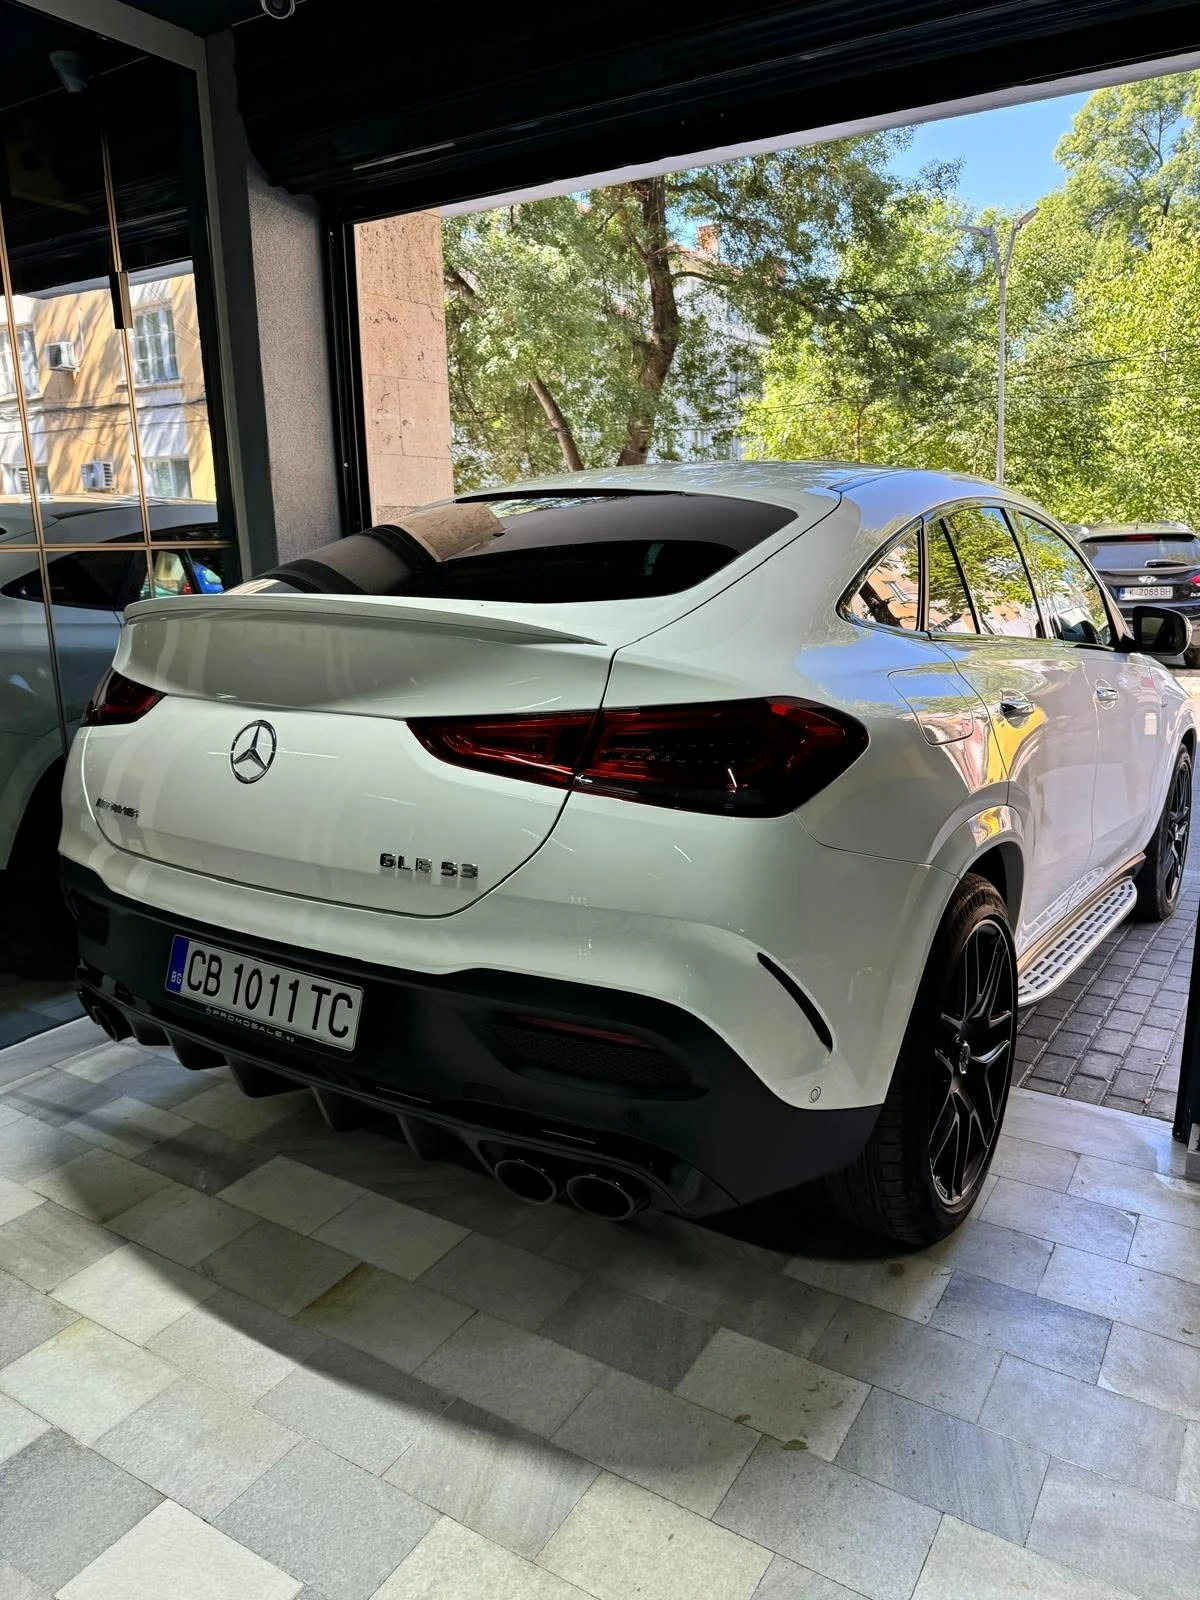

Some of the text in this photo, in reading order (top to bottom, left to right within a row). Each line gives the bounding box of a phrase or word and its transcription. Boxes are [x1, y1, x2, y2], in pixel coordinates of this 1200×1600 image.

[380, 852, 479, 879] GLE 53
[171, 970, 183, 985] BG
[187, 950, 353, 1039] CB 1011 TC
